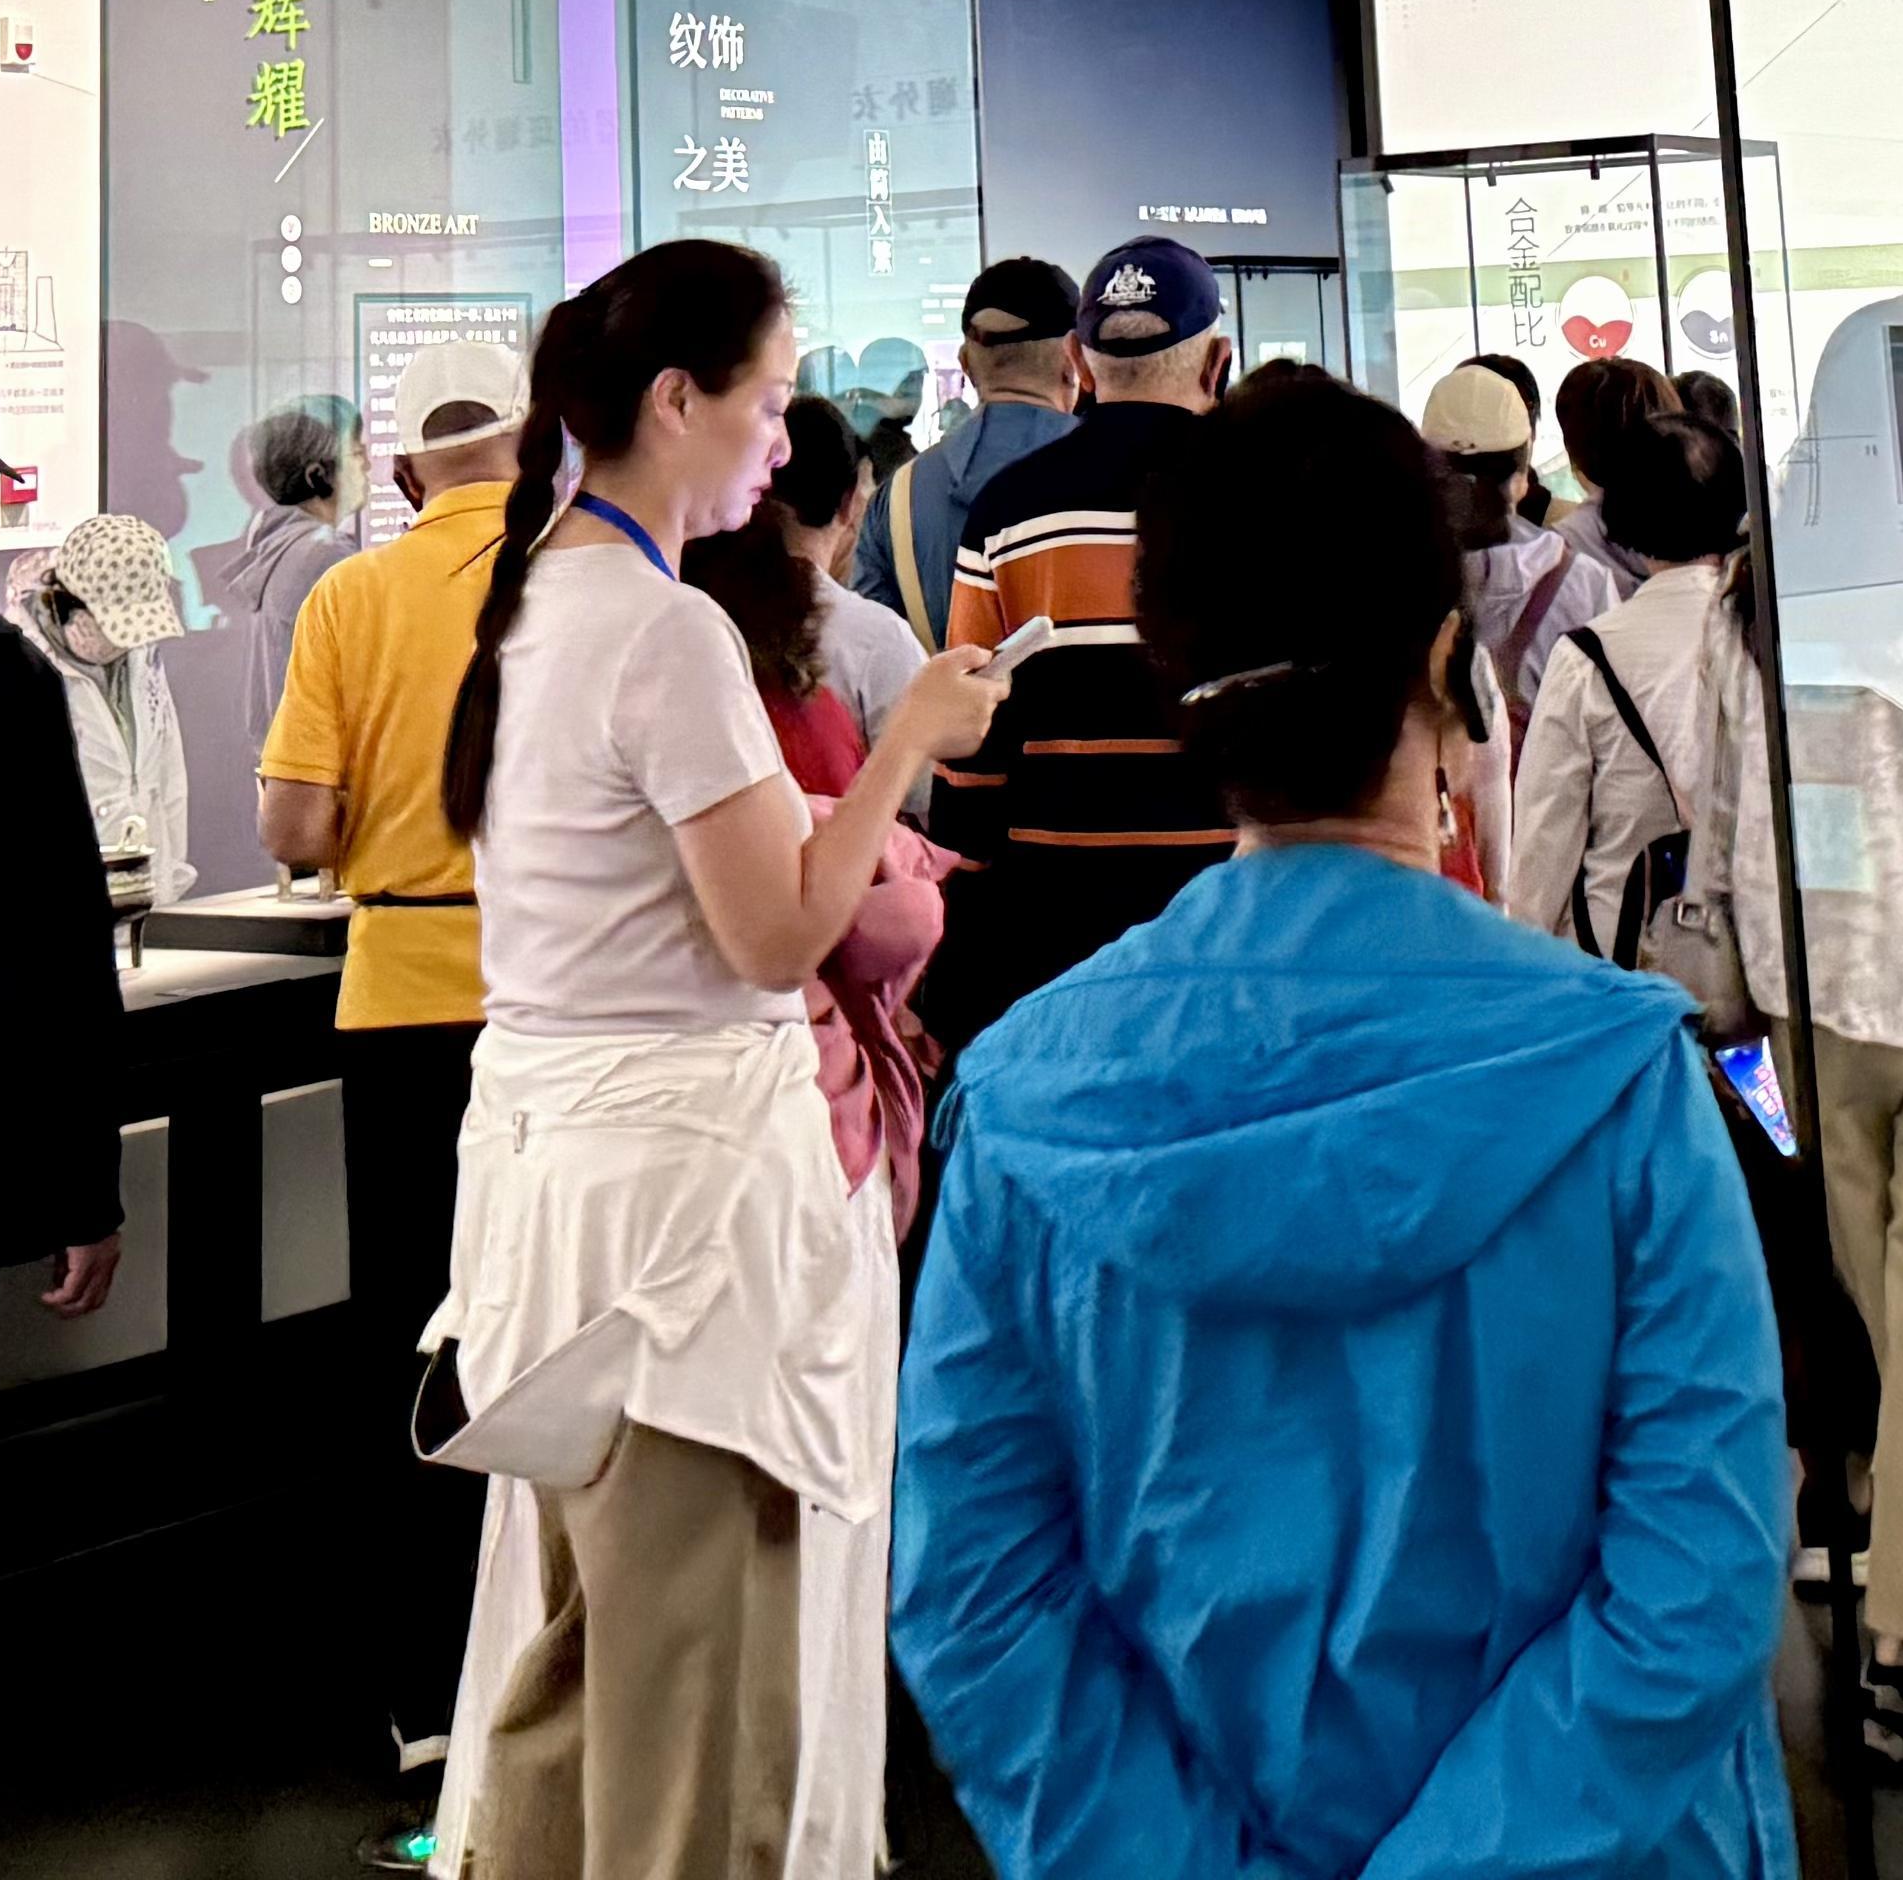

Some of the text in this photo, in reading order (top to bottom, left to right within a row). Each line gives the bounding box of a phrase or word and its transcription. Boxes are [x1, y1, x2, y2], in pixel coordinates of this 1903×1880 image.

[669, 12, 745, 71] 纹饰
[673, 134, 750, 193] 之美
[368, 212, 480, 235] BRONZE ART
[1505, 198, 1546, 347] 合金配比
